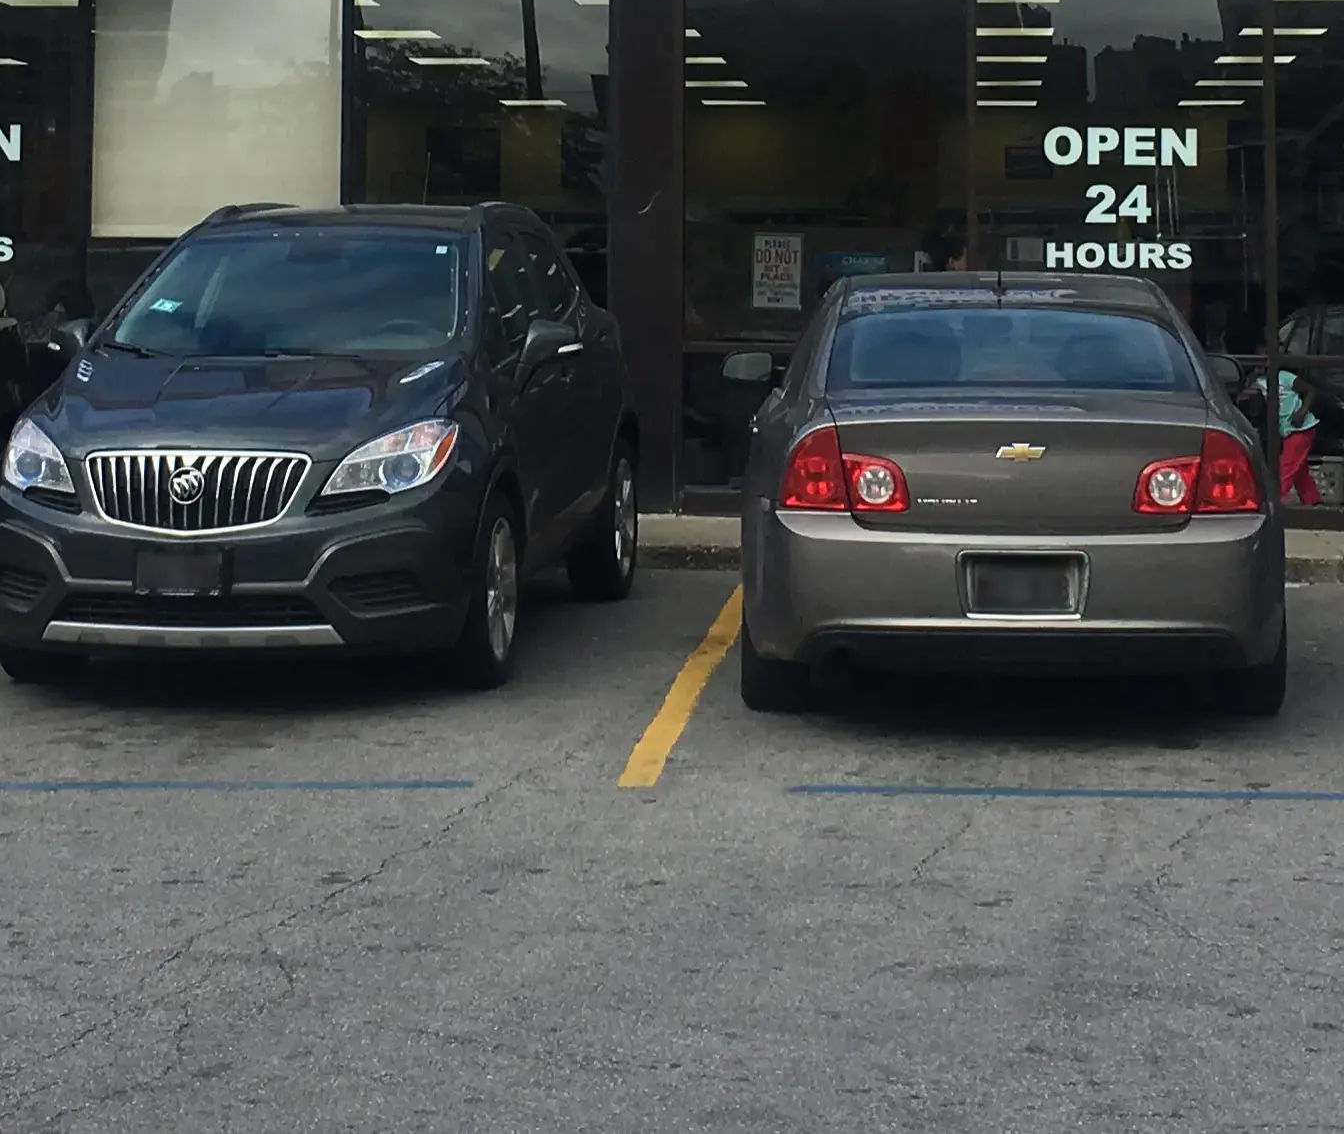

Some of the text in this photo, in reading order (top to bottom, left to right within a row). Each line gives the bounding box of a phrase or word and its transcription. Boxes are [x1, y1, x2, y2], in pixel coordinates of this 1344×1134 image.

[1044, 126, 1198, 167] OPEN
[1085, 184, 1152, 224] 24
[756, 248, 799, 265] DO NOT
[1046, 242, 1193, 269] HOURS
